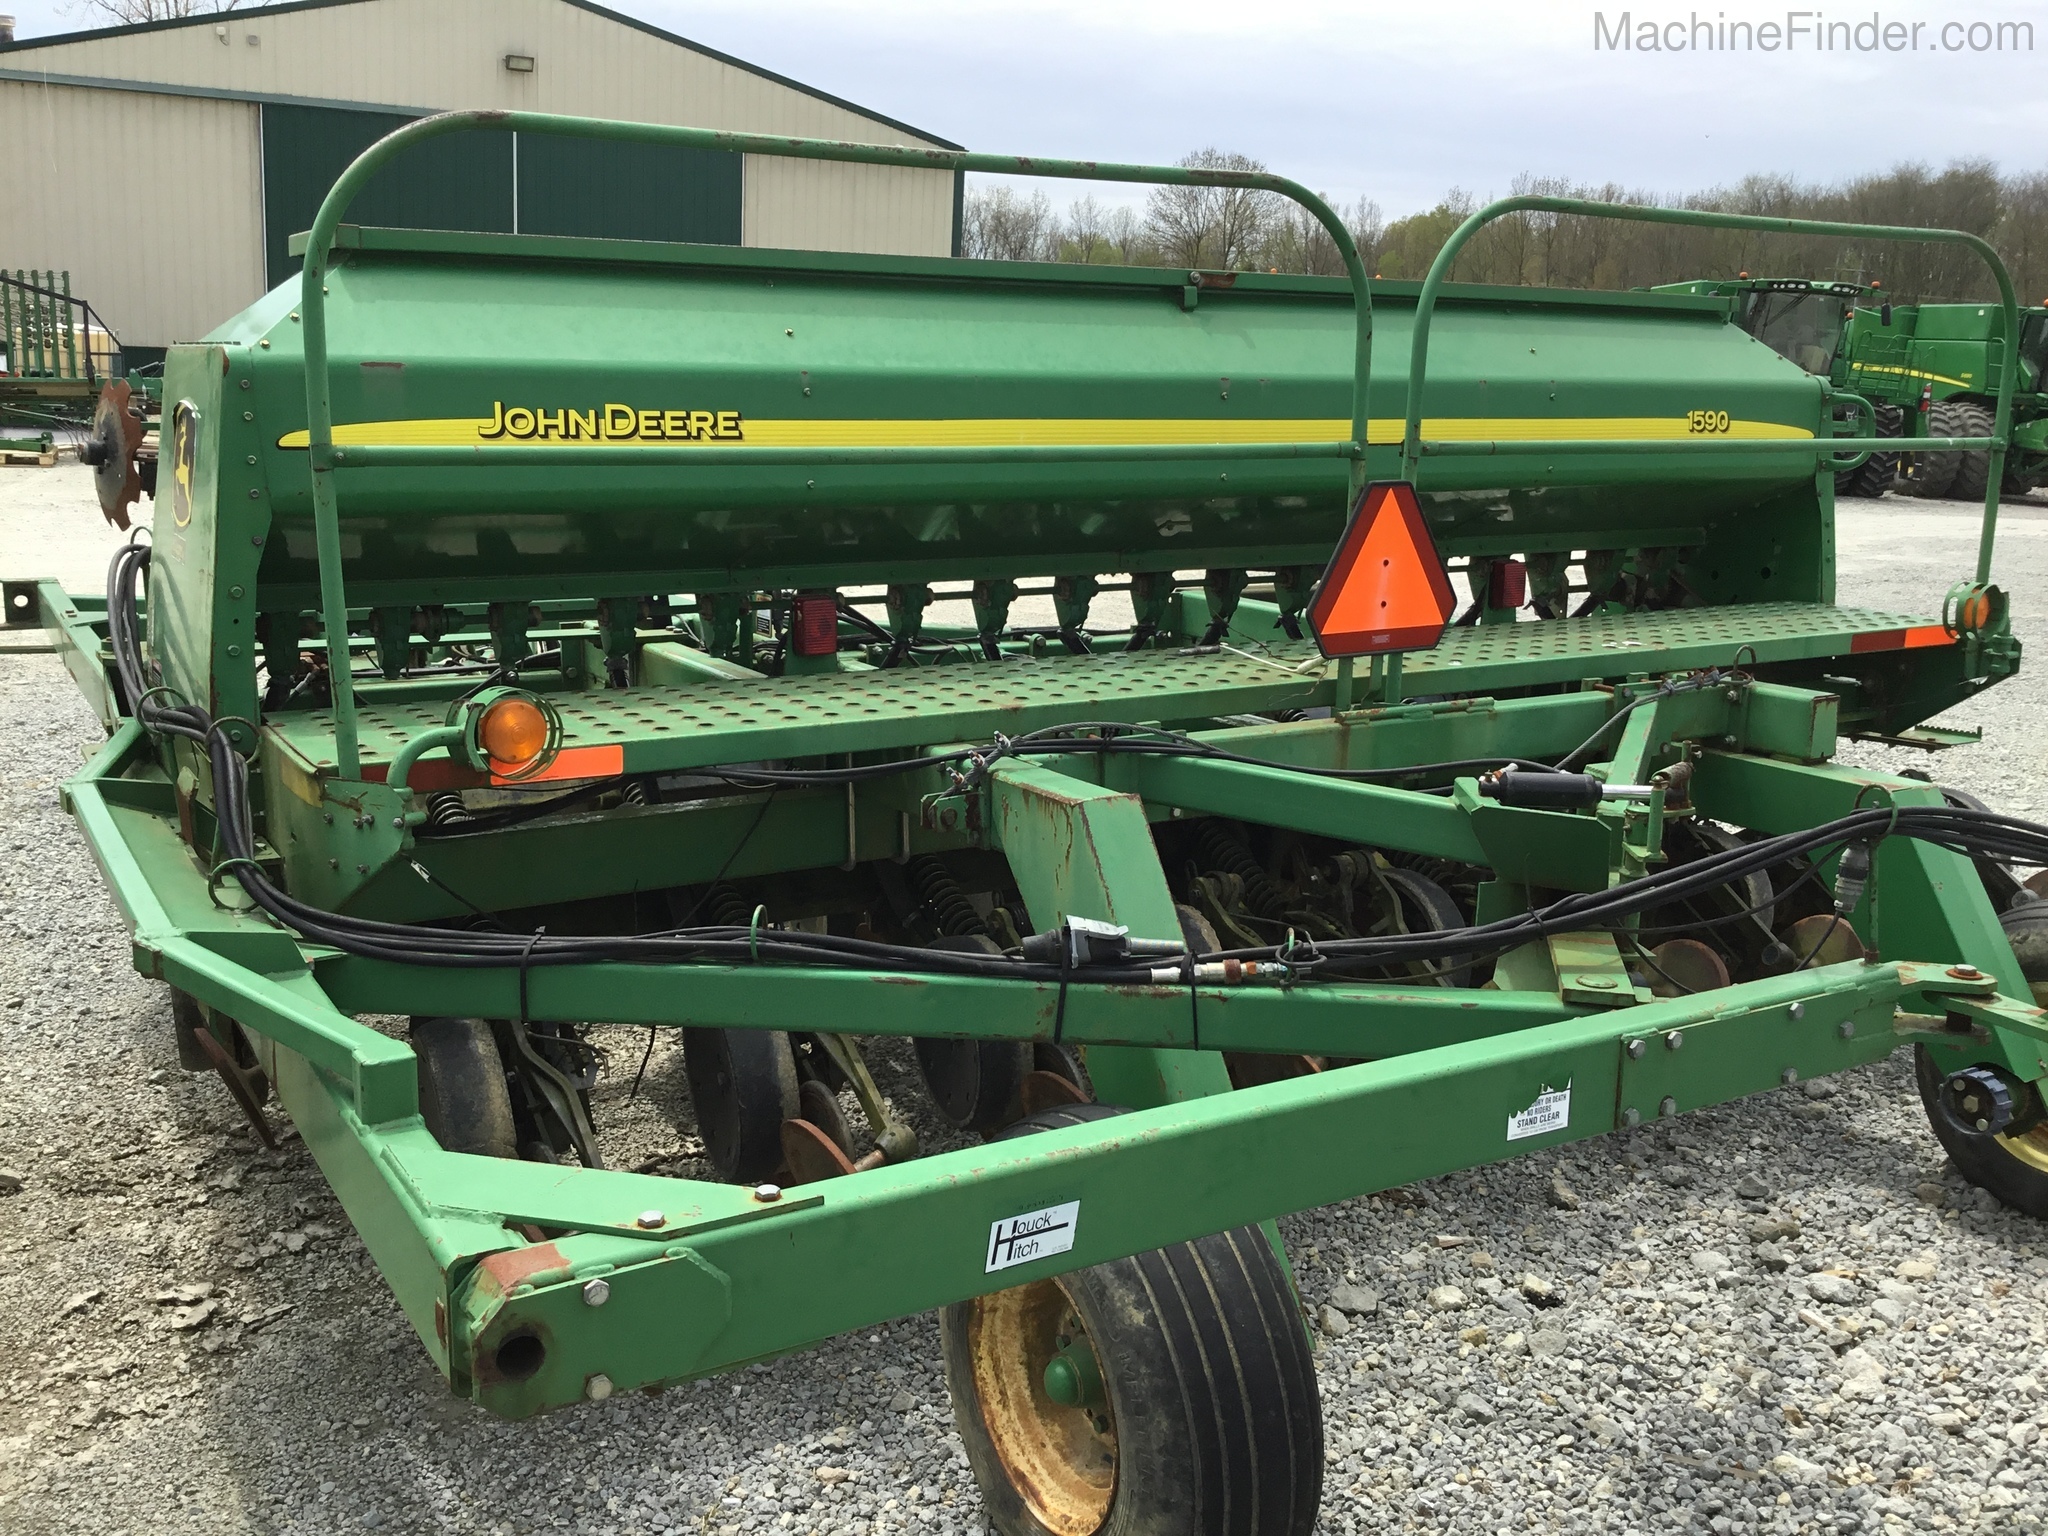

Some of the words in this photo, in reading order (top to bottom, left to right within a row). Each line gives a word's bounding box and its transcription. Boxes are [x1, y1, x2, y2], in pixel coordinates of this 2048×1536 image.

[478, 401, 600, 440] JOHN
[603, 402, 743, 441] DEERE
[1687, 410, 1730, 433] 1590
[1552, 1093, 1567, 1103] DEATH
[1517, 1116, 1538, 1128] STAND
[1539, 1111, 1560, 1124] CLEAR
[1527, 1108, 1534, 1117] NO
[1534, 1104, 1552, 1115] RIDERS
[994, 1212, 1052, 1245] Houck
[991, 1238, 1039, 1266] Hitch
